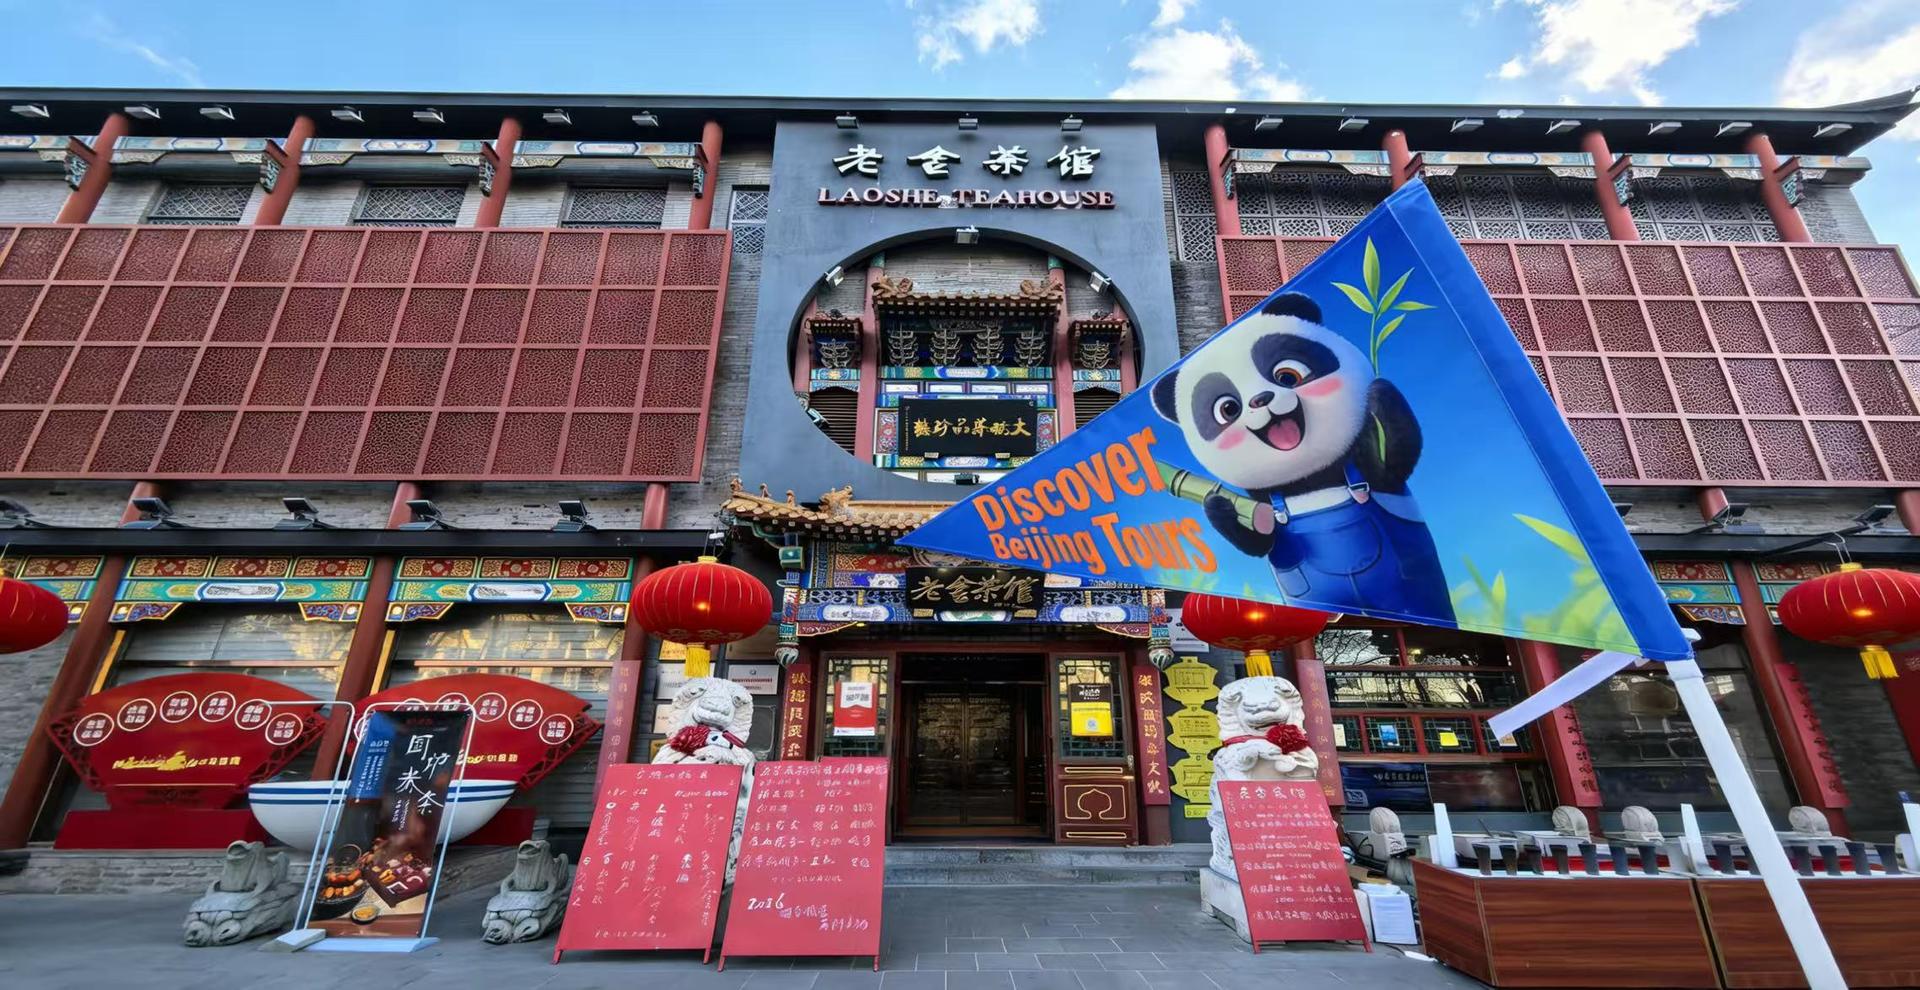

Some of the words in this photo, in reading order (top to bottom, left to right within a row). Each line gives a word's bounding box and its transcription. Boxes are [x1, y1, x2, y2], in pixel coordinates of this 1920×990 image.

[832, 144, 1101, 178] 老舍茶馆
[818, 187, 940, 207] LAOSHE
[952, 188, 1117, 209] TEAHOUSE
[972, 426, 1167, 531] Discover
[989, 526, 1107, 575] Beijing
[1091, 511, 1218, 574] Tours
